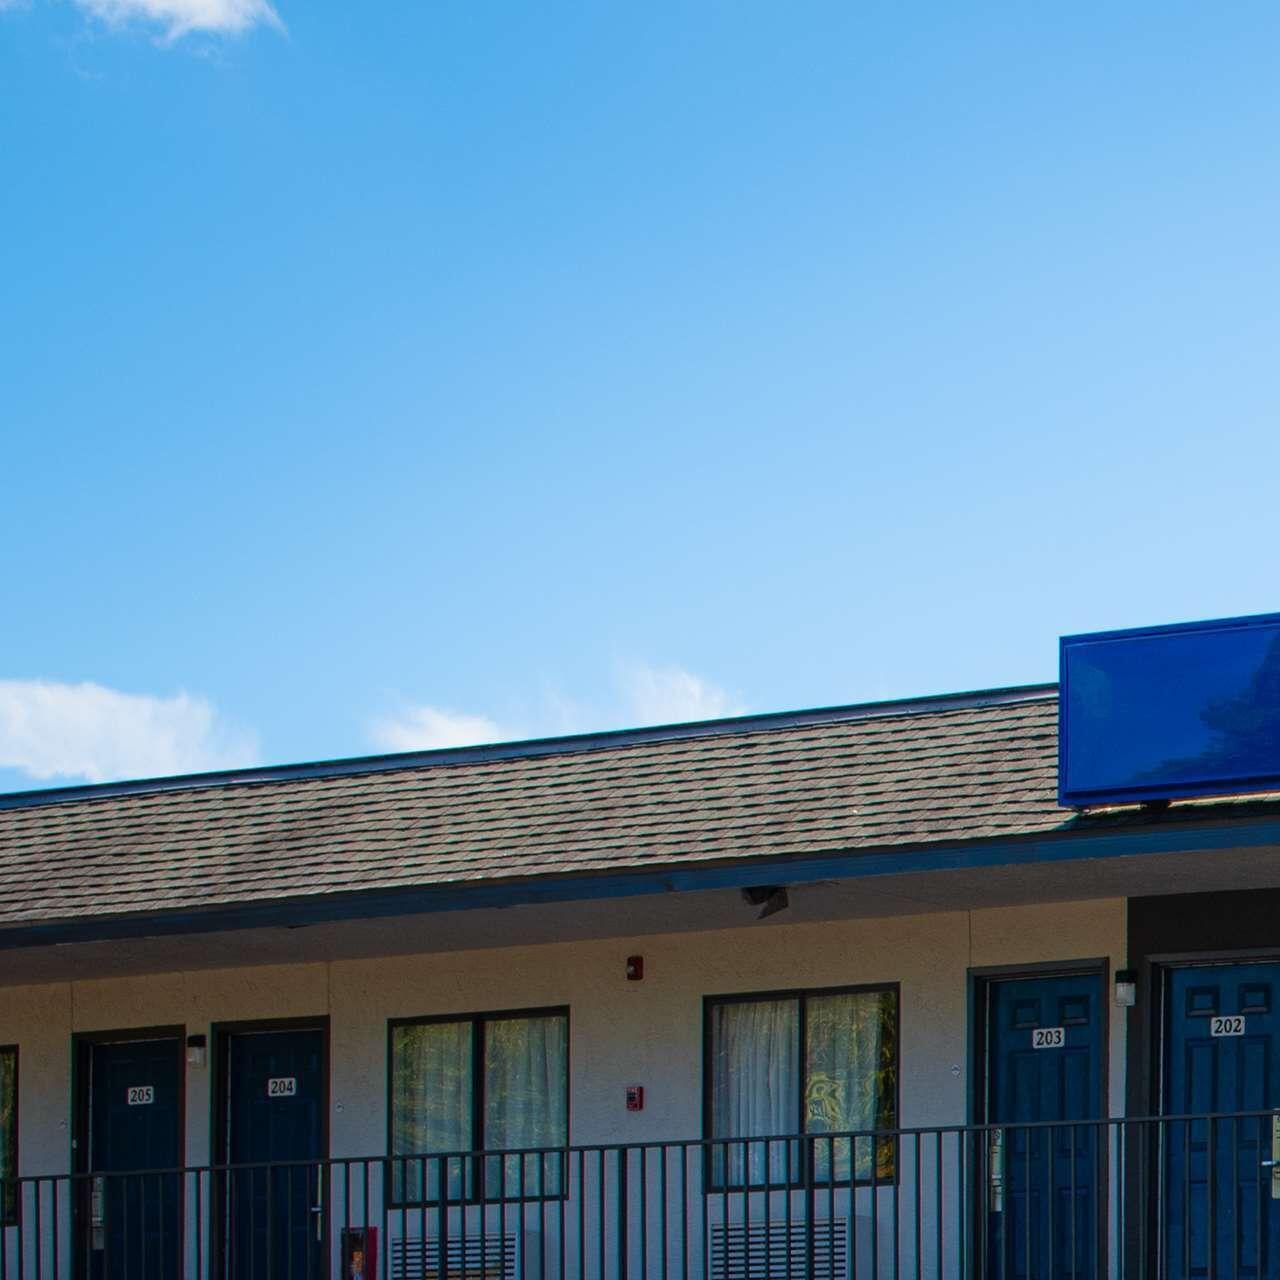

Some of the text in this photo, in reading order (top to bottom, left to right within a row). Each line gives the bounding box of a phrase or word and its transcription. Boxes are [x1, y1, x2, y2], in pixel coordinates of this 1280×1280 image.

[1213, 1018, 1242, 1034] 202
[1036, 1030, 1062, 1046] 203
[270, 1080, 294, 1094] 204
[130, 1088, 152, 1103] 205
